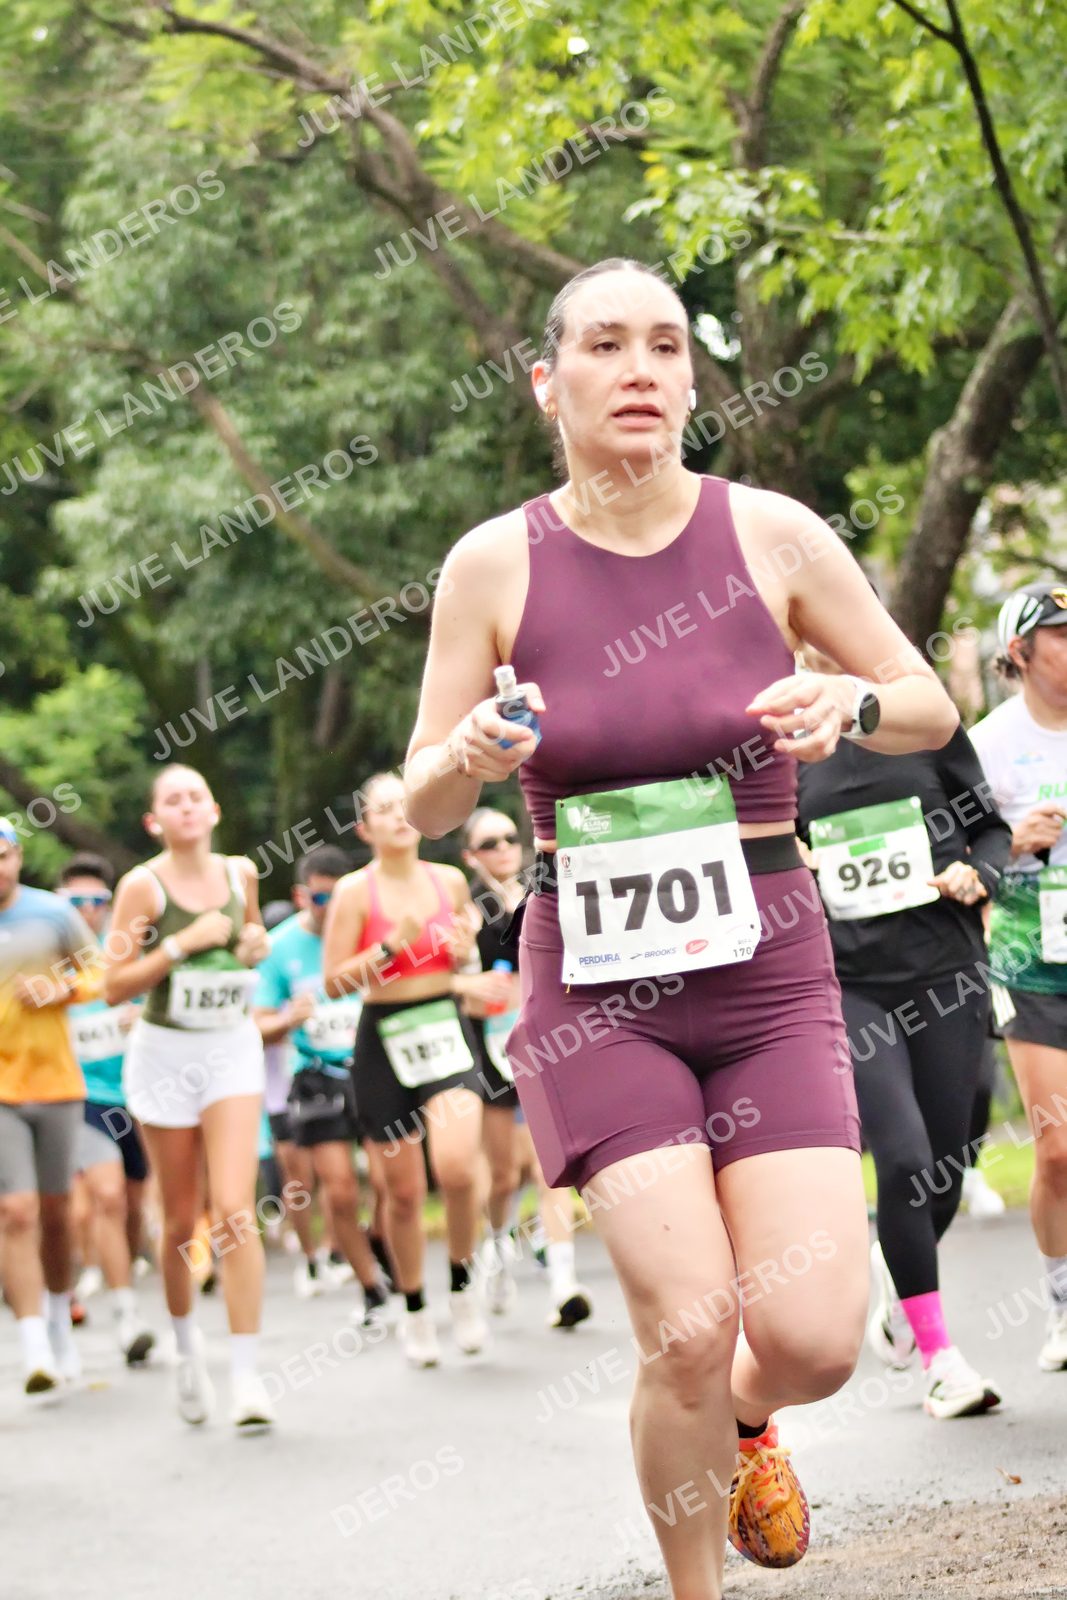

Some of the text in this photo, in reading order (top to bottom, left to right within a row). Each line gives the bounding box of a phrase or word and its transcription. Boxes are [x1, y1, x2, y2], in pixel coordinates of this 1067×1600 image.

[838, 851, 911, 892] 926
[576, 860, 733, 936] 1701
[578, 952, 622, 967] PERDURA
[644, 946, 677, 959] BROOKS
[733, 945, 754, 958] 170
